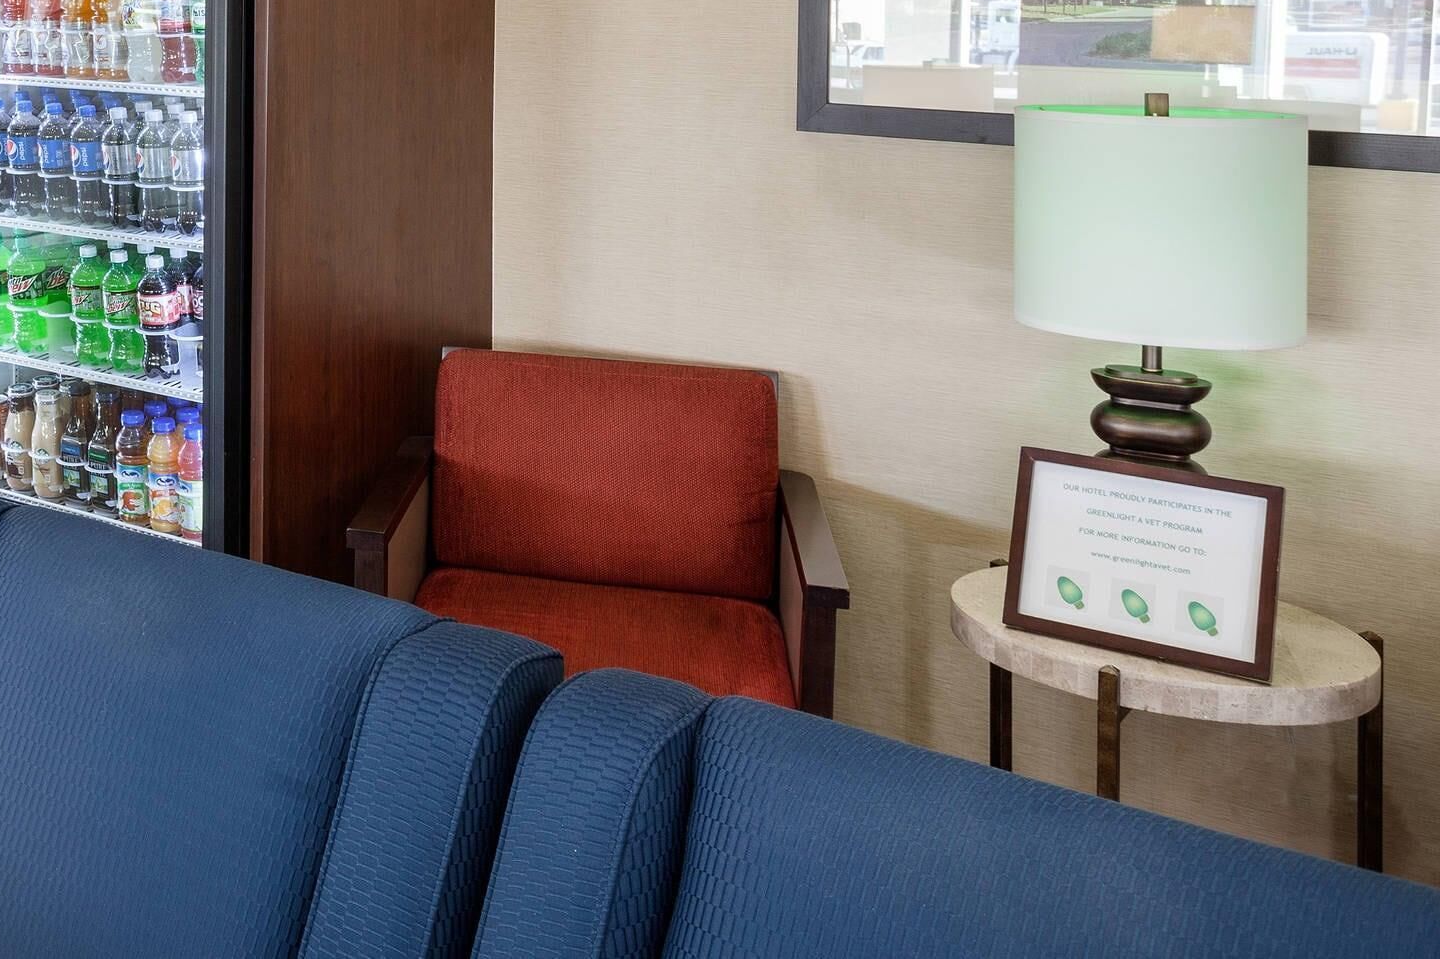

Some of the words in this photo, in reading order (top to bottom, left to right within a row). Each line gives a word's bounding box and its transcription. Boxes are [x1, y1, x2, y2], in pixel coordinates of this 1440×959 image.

[1063, 483, 1079, 492] OUR
[1082, 486, 1107, 496] HOTEL
[1110, 491, 1146, 503] PROUDLY
[1148, 497, 1202, 513] PARTICIPATES
[1204, 506, 1212, 515] IN
[1215, 508, 1232, 518] THE
[1086, 508, 1136, 522] GREENLIGHT
[1145, 517, 1161, 527] VET
[1163, 520, 1203, 534] PROGRAM
[1079, 527, 1094, 537] FOR
[1097, 530, 1119, 541] MORE
[1121, 534, 1176, 551] INFORMATION
[1178, 544, 1191, 554] GO
[1193, 547, 1207, 556] TO:
[1091, 551, 1191, 575] www.greenlightavet.com
